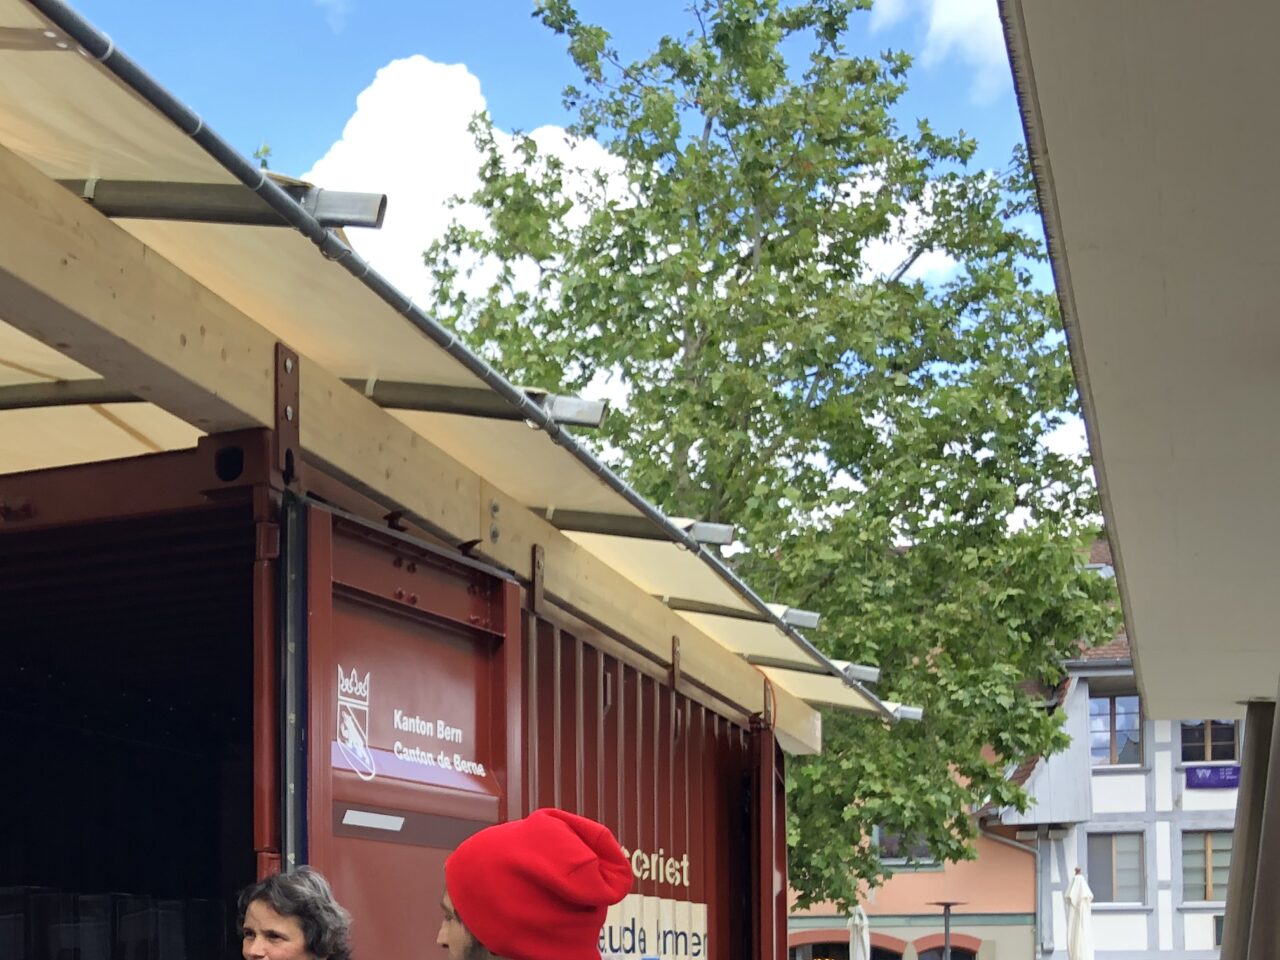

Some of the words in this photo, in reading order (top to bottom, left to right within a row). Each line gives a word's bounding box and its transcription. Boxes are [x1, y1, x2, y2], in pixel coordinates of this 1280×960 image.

[393, 708, 434, 737] Kanton
[436, 719, 463, 744] Bern
[393, 740, 436, 767] Canton
[437, 750, 452, 770] de
[453, 754, 487, 778] Berne
